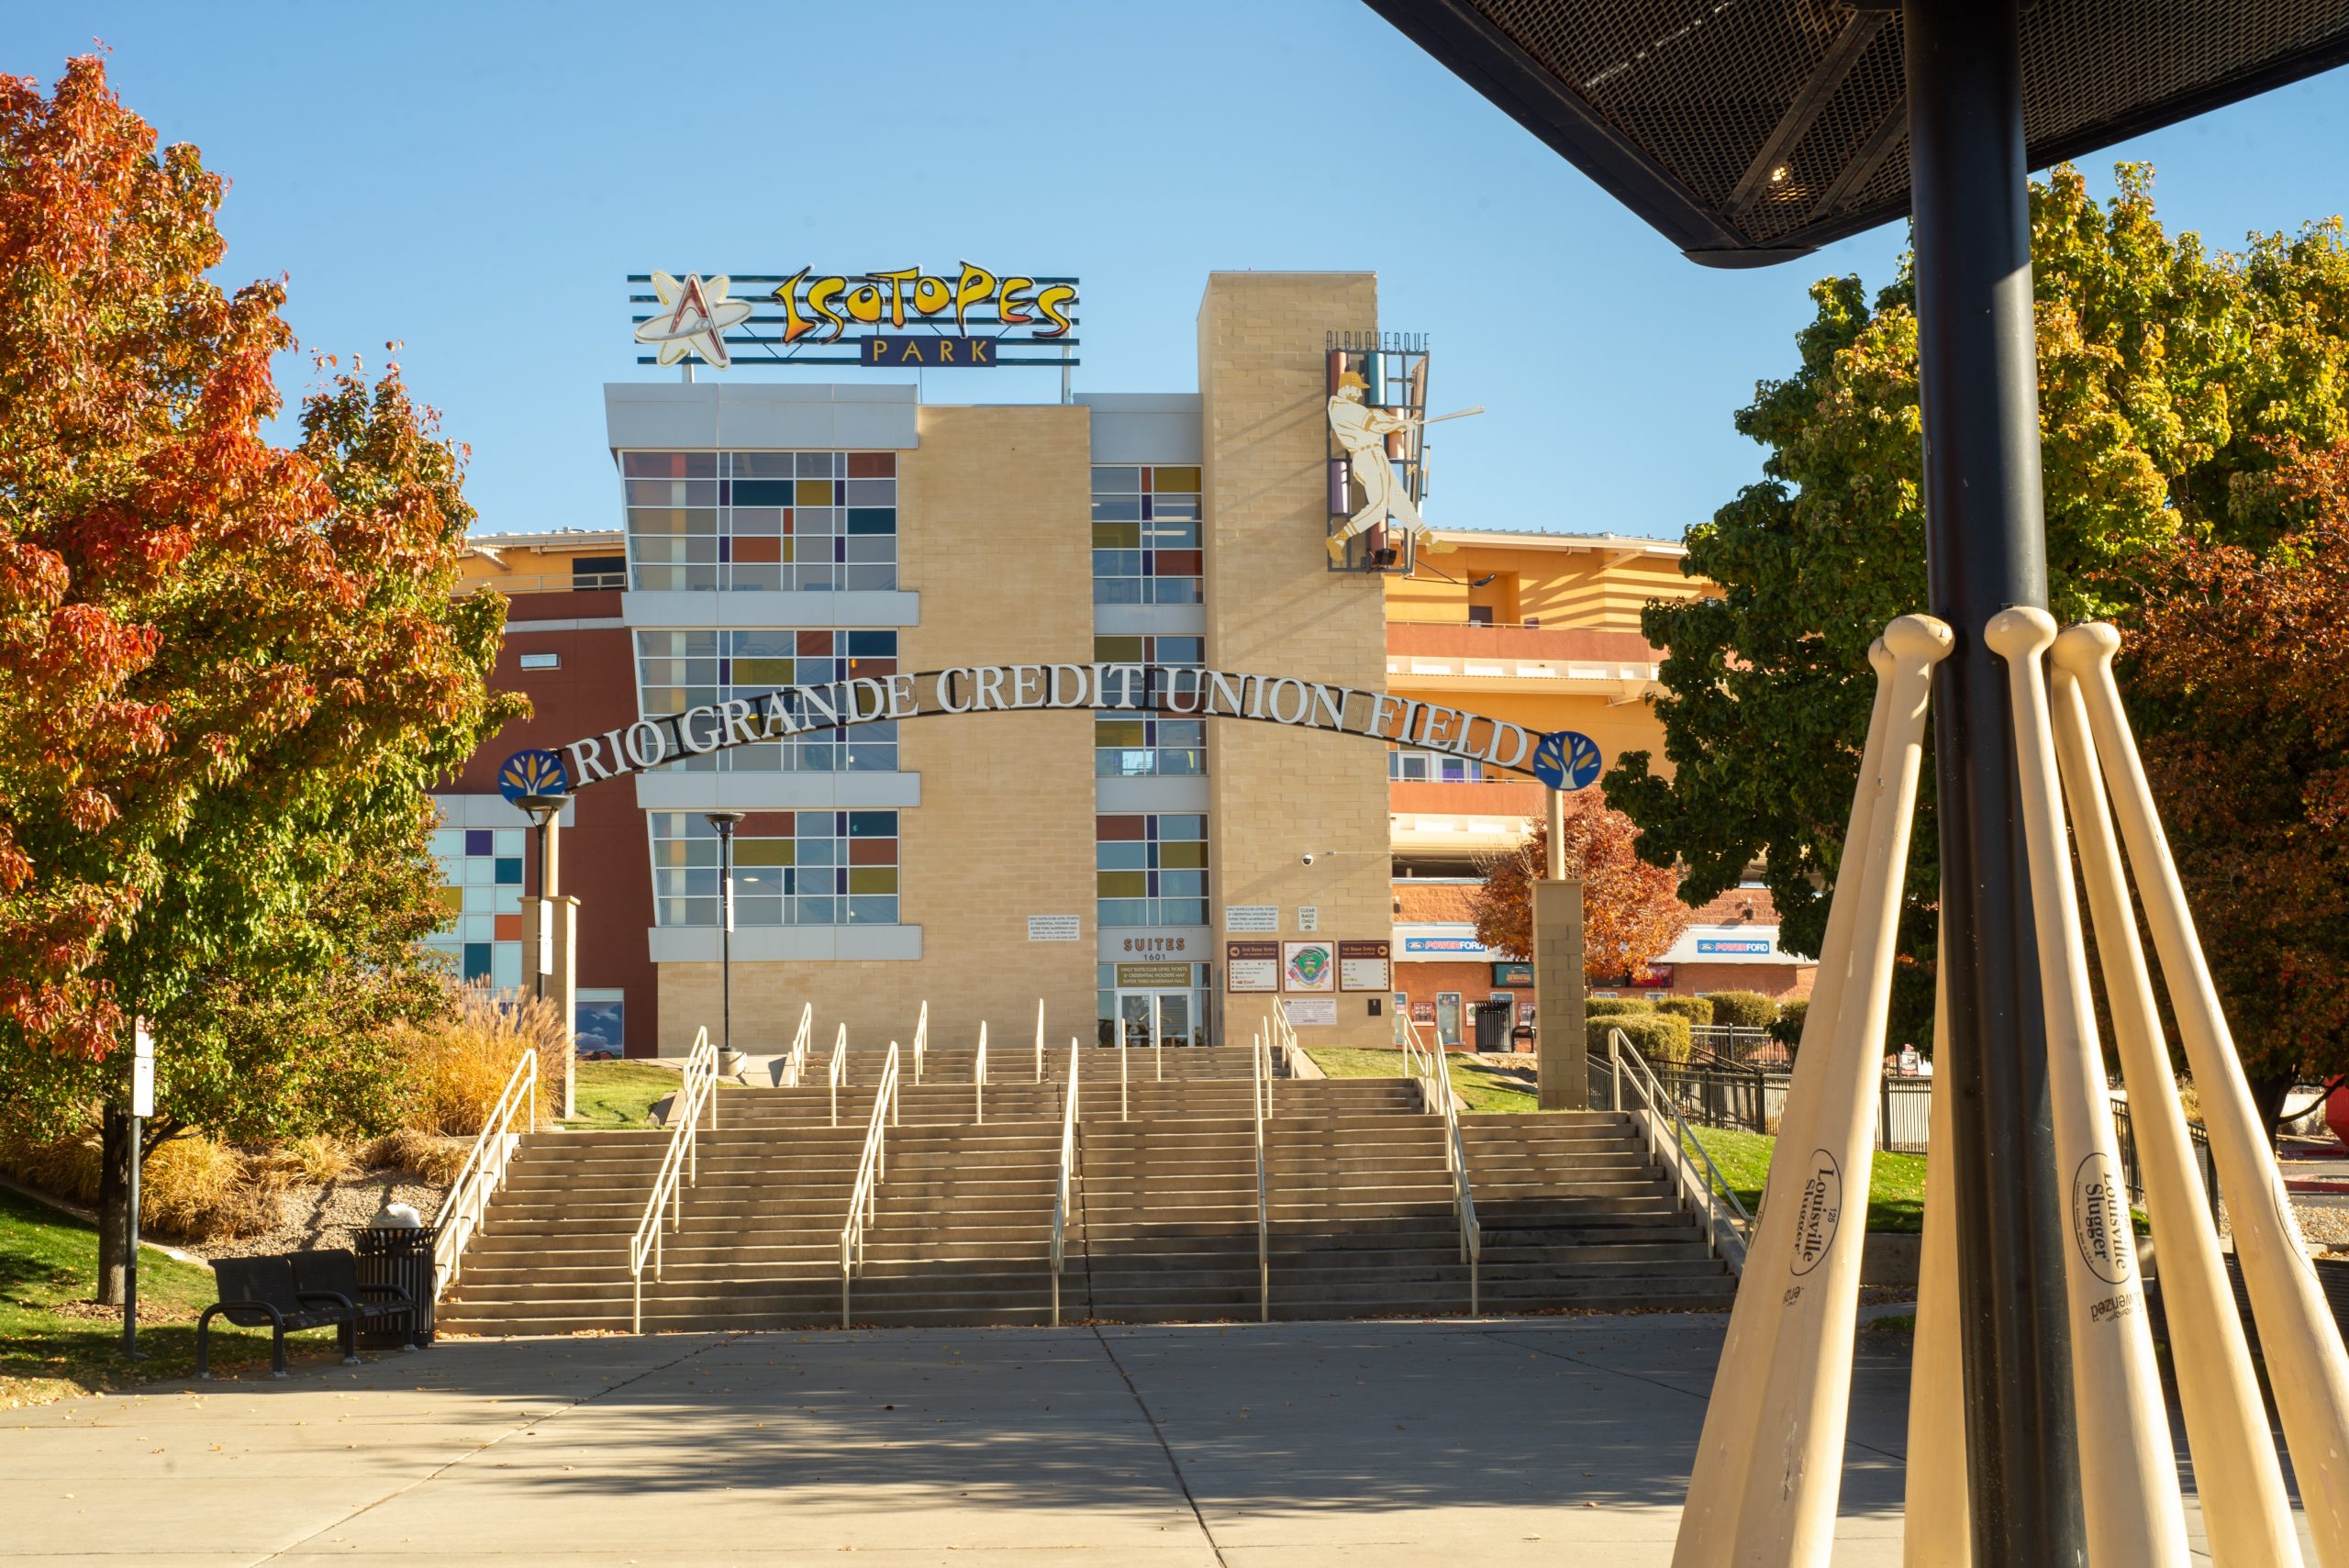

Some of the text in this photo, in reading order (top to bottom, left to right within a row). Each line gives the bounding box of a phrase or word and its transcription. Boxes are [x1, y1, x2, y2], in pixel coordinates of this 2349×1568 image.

[873, 339, 987, 362] PARK
[1326, 330, 1431, 351] ALBUQUERQUE
[565, 662, 1528, 786] RIO GRANDE CREDIT UNION FIELD
[1124, 938, 1185, 951] SUITES
[1803, 1168, 1834, 1262] Louisville
[1828, 1208, 1837, 1223] 125
[2085, 1183, 2108, 1261] Slugger
[2103, 1172, 2127, 1270] Louisville
